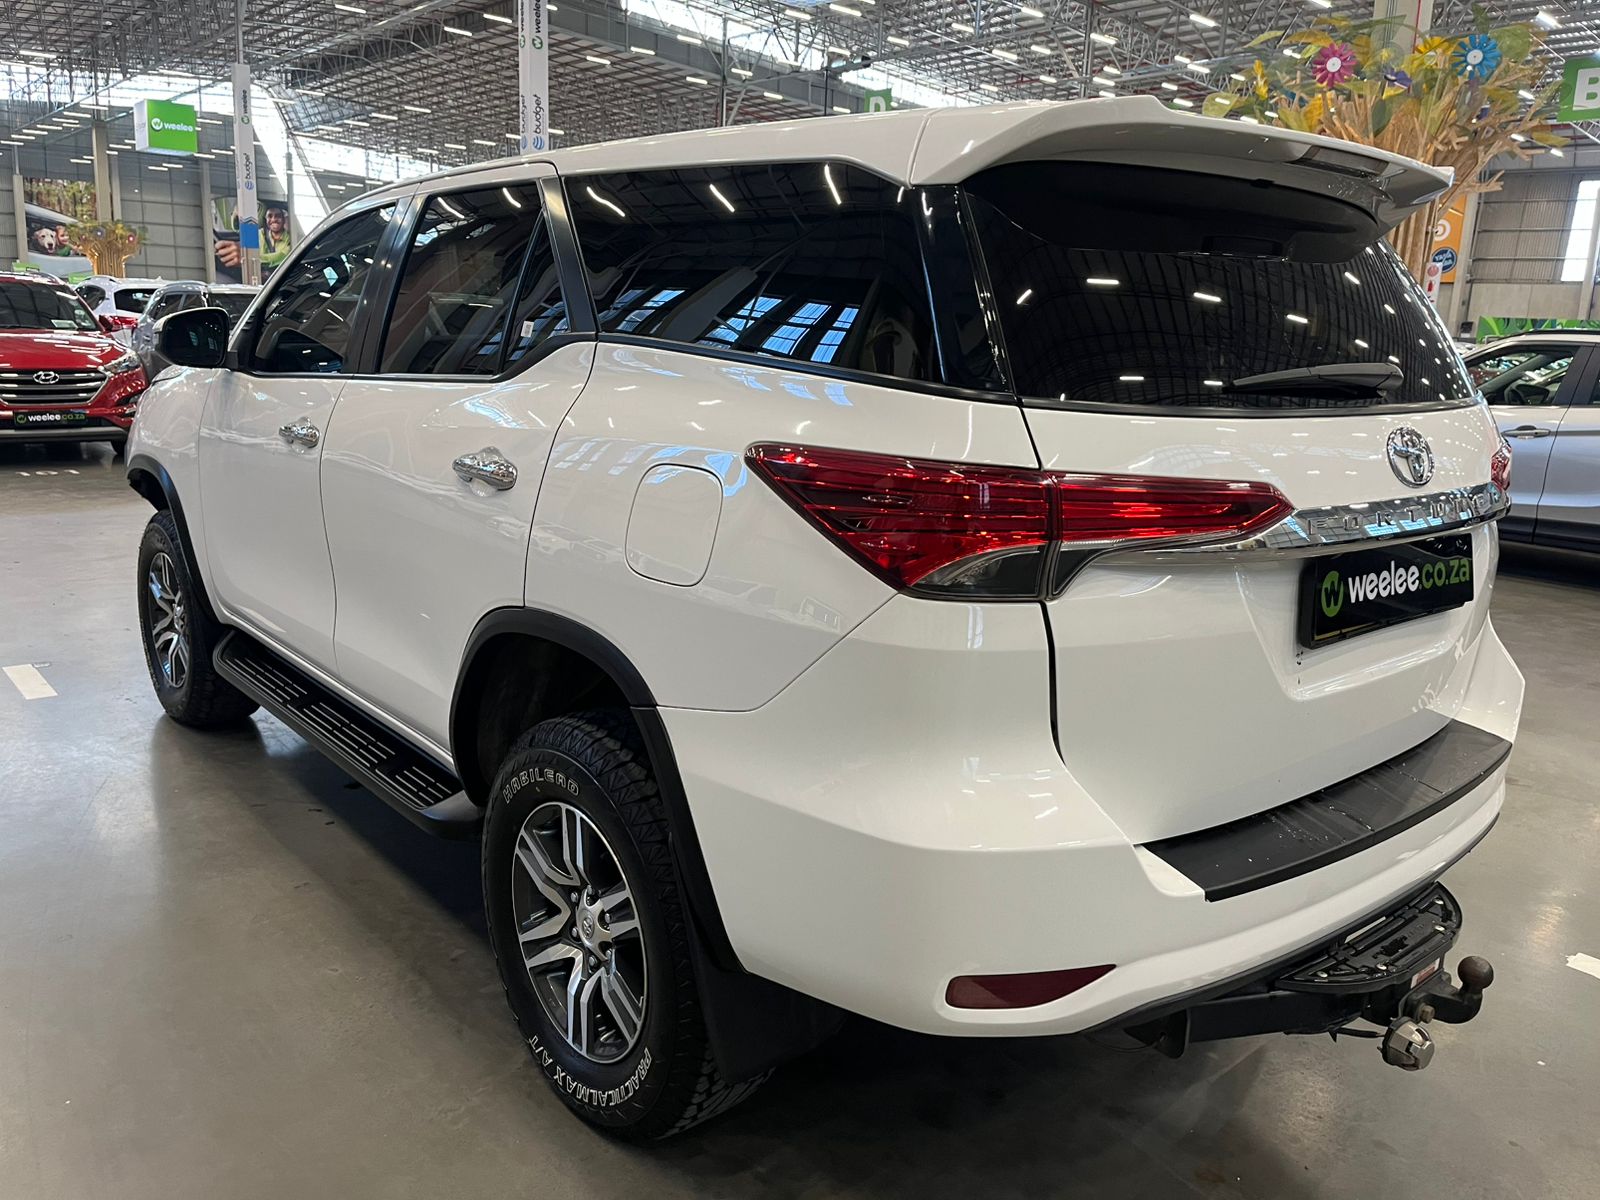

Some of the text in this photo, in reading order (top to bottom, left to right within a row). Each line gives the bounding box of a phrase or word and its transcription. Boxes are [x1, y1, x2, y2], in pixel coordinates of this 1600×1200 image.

[1572, 67, 1600, 111] B
[533, 94, 545, 134] budget
[502, 767, 579, 804] HABILEAD
[528, 1035, 653, 1107] PRACTICALMAX A/T
